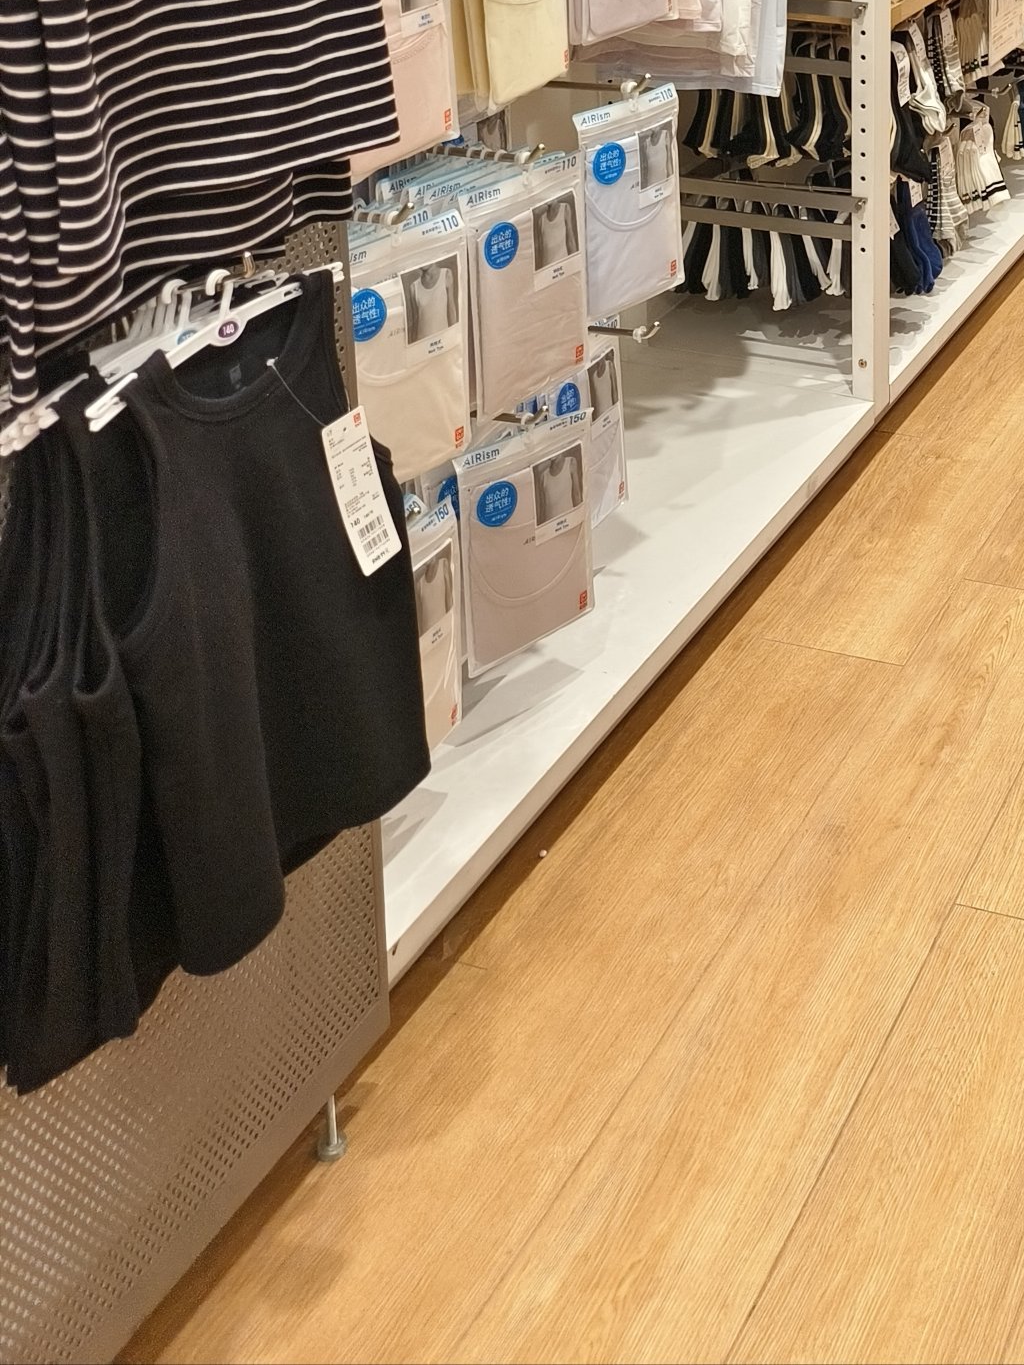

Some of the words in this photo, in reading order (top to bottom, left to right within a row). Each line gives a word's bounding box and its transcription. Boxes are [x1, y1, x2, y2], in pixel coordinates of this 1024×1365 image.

[580, 111, 611, 127] AIRism
[661, 88, 673, 102] 110
[466, 187, 501, 206] AIRism
[562, 155, 577, 173] 110
[412, 209, 429, 225] 110
[441, 214, 459, 232] 110
[490, 228, 512, 246] 出众的
[352, 296, 376, 314] 出众的
[221, 323, 235, 336] 140
[463, 447, 500, 468] AIRism
[569, 411, 587, 426] 150
[485, 486, 509, 504] 出众的
[434, 502, 450, 523] 150
[350, 517, 361, 529] 140
